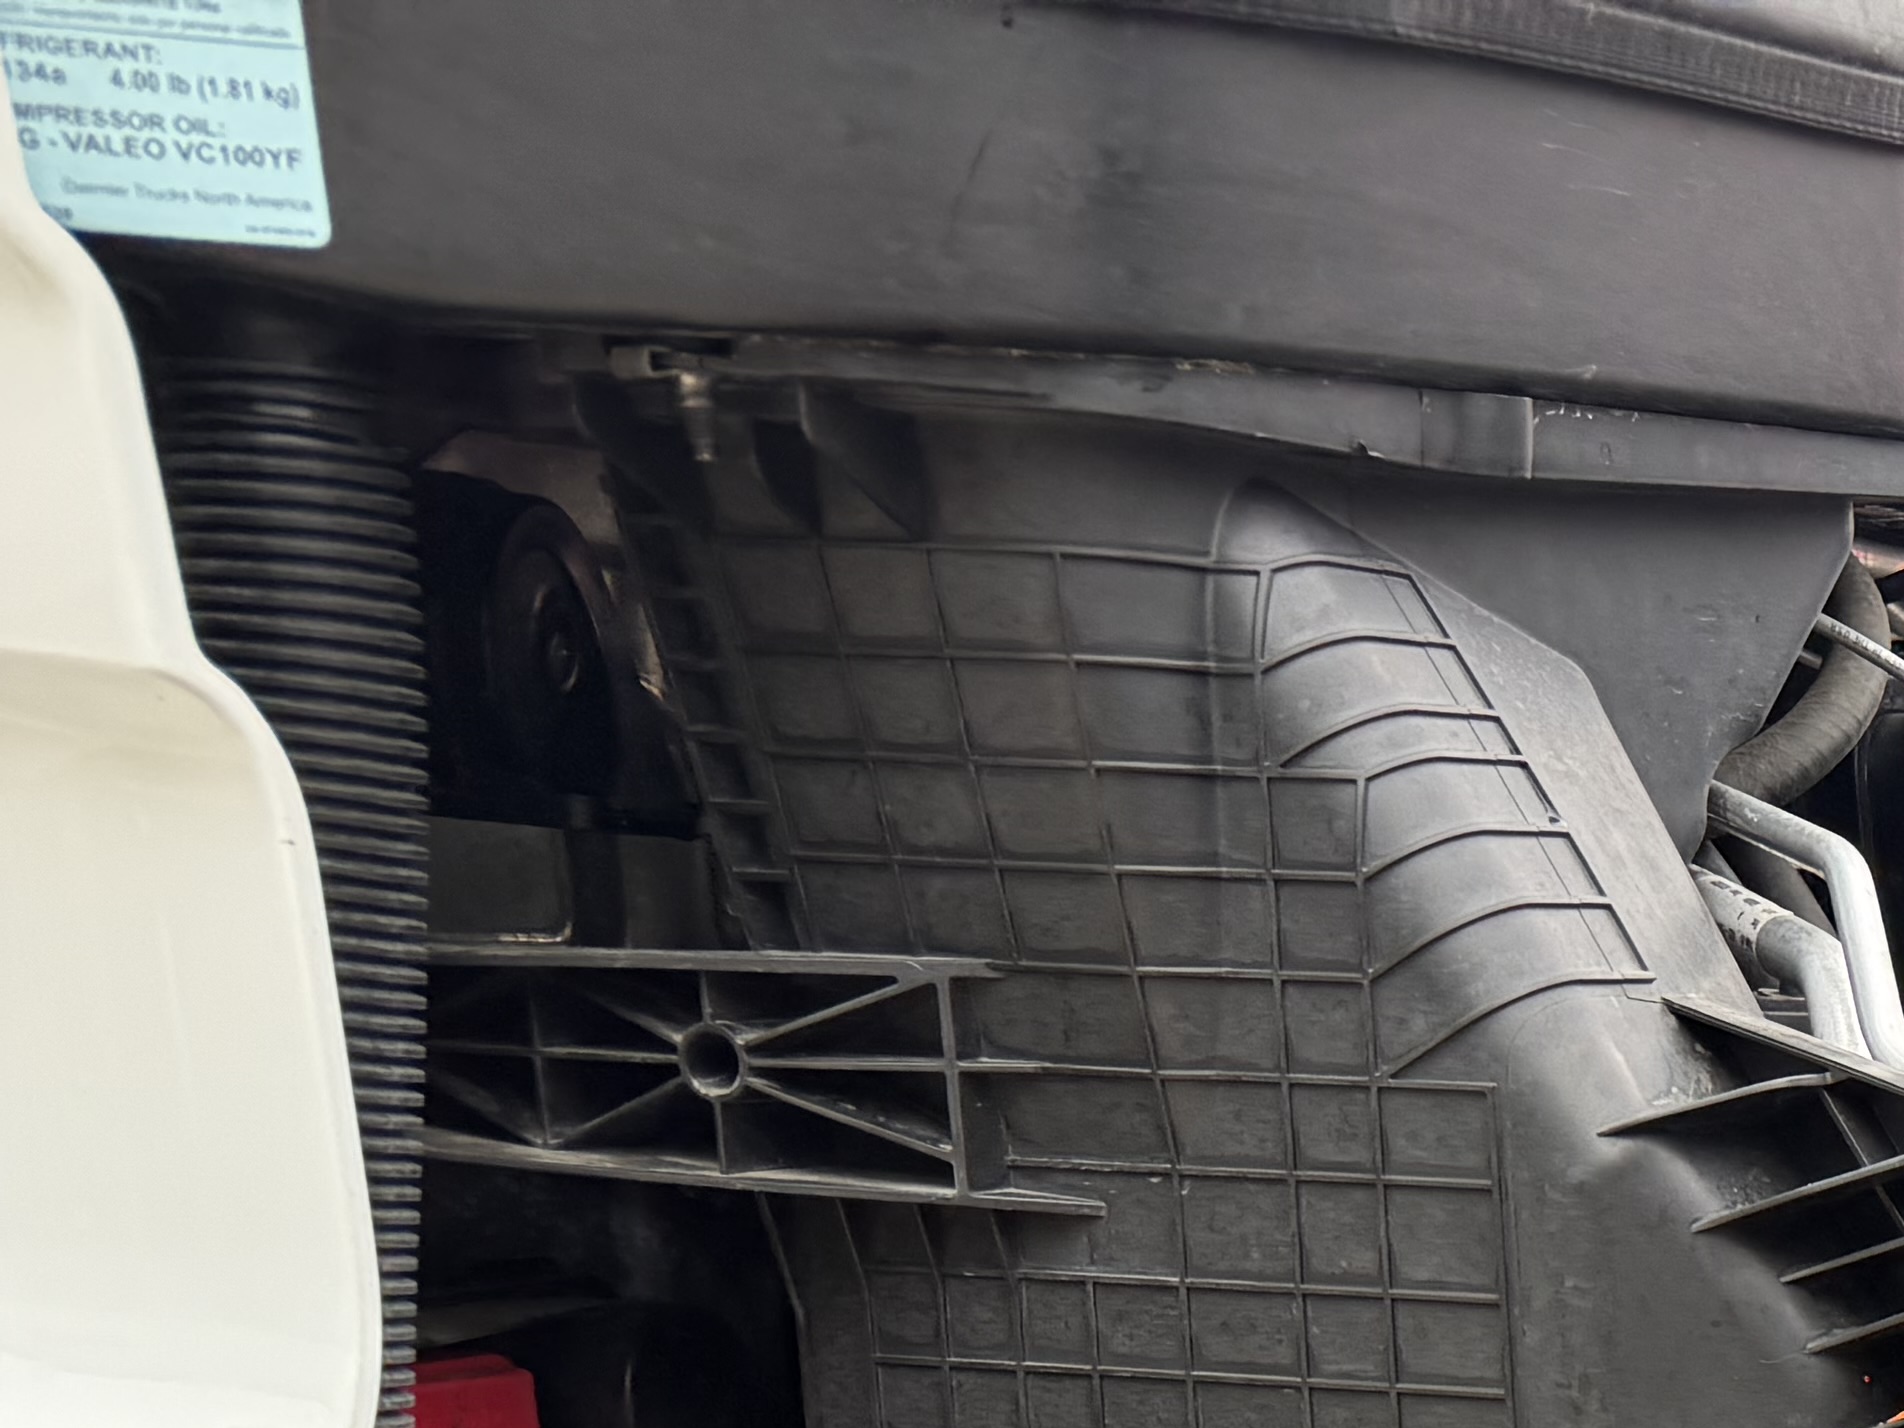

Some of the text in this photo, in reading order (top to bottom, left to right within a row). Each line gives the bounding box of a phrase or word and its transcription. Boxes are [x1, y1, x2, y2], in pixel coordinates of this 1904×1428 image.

[167, 72, 191, 96] lb
[262, 81, 300, 110] kg)
[173, 114, 225, 138] OIL:
[60, 131, 166, 161] VALEO
